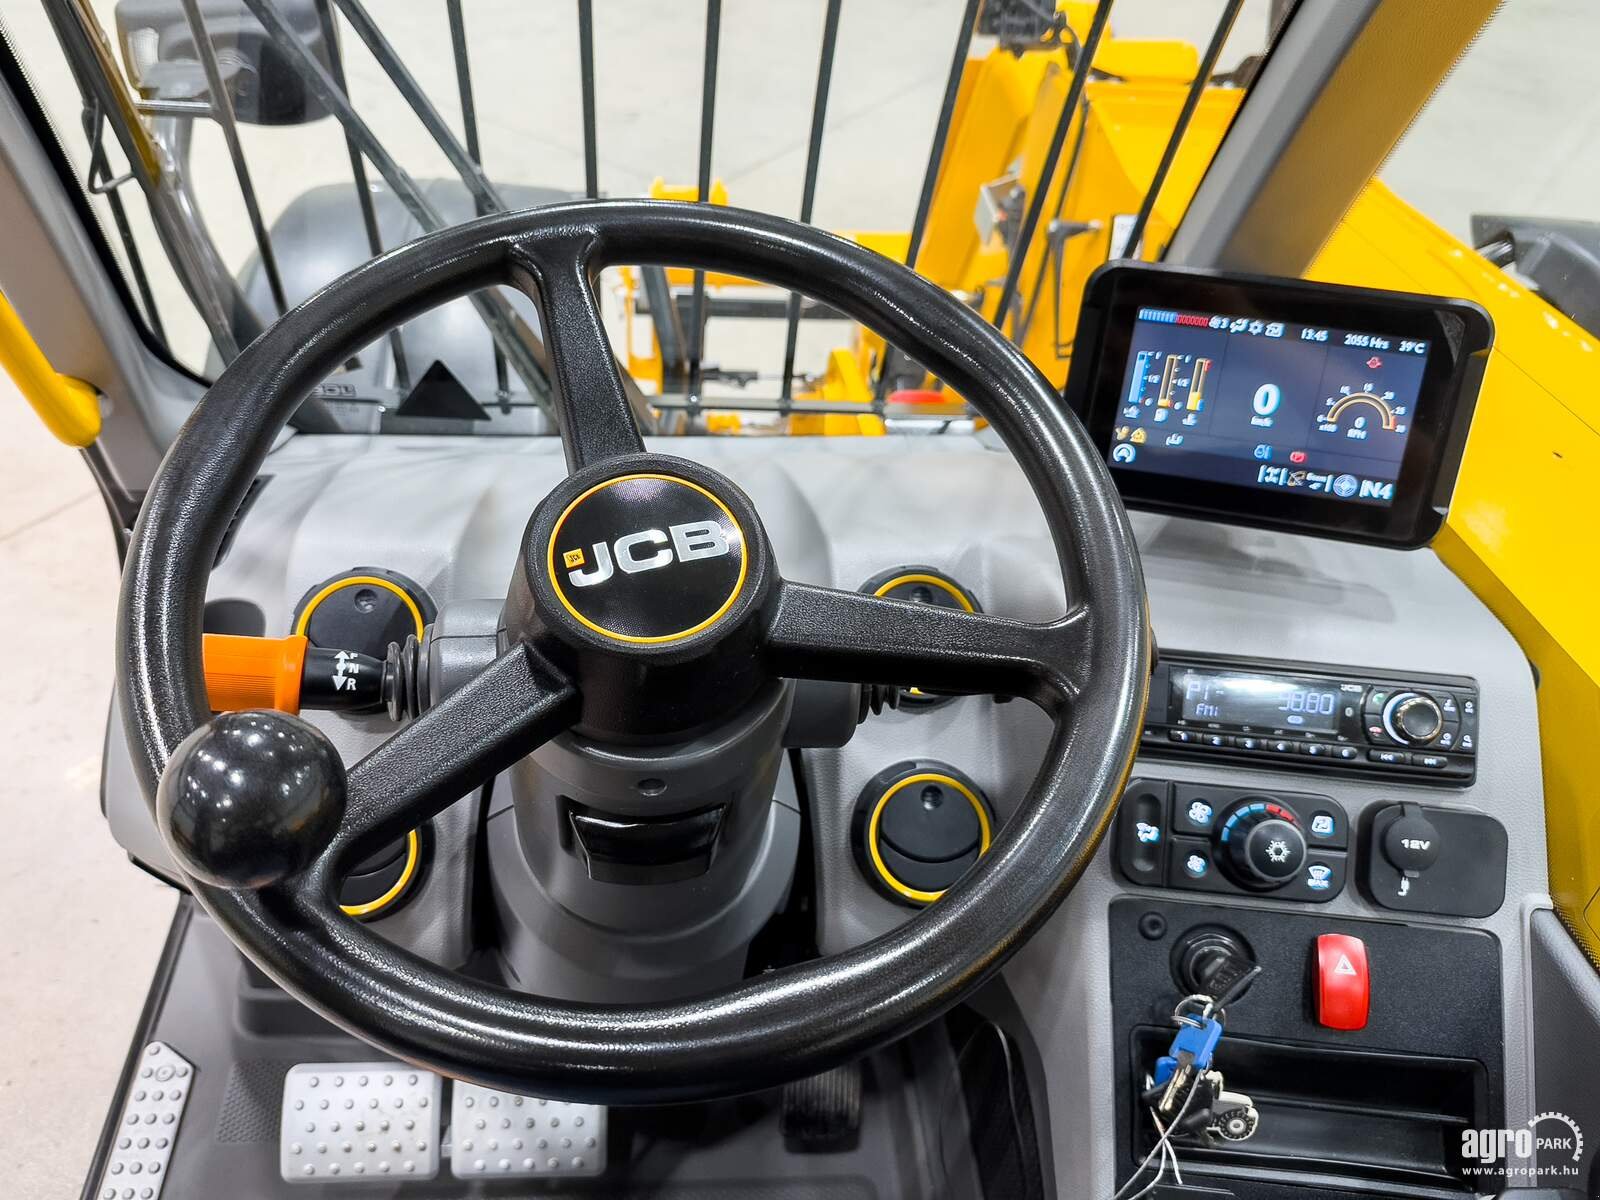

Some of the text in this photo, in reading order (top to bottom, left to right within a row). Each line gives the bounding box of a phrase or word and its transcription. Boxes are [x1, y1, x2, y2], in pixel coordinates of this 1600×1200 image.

[1301, 328, 1328, 342] 13:45
[1253, 383, 1280, 416] 0
[568, 520, 730, 588] JCB
[350, 652, 359, 660] F
[348, 662, 360, 674] N
[346, 677, 357, 691] R
[1401, 838, 1431, 850] 12V
